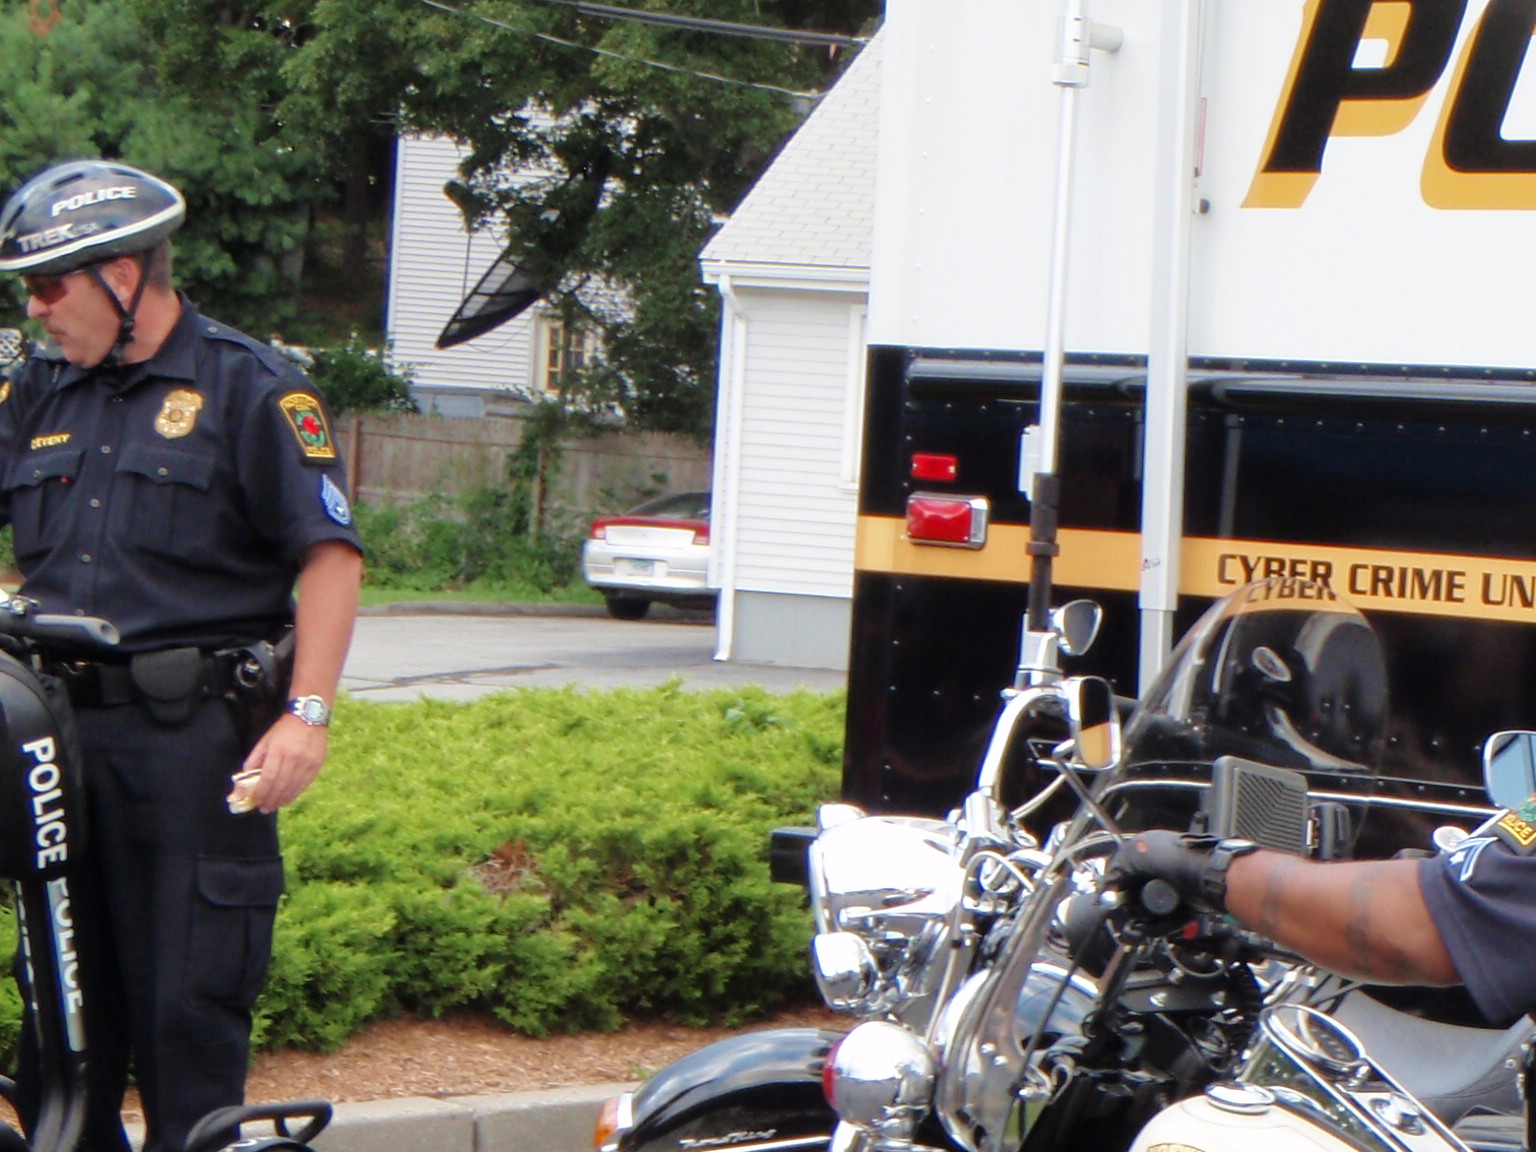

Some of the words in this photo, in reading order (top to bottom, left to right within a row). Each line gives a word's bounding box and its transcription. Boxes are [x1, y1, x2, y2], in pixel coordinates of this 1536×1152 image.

[51, 186, 137, 217] POLICE
[16, 222, 74, 253] TREK
[1217, 553, 1336, 601] CYBER
[1348, 563, 1466, 603] CRIME
[22, 736, 68, 869] POLICE
